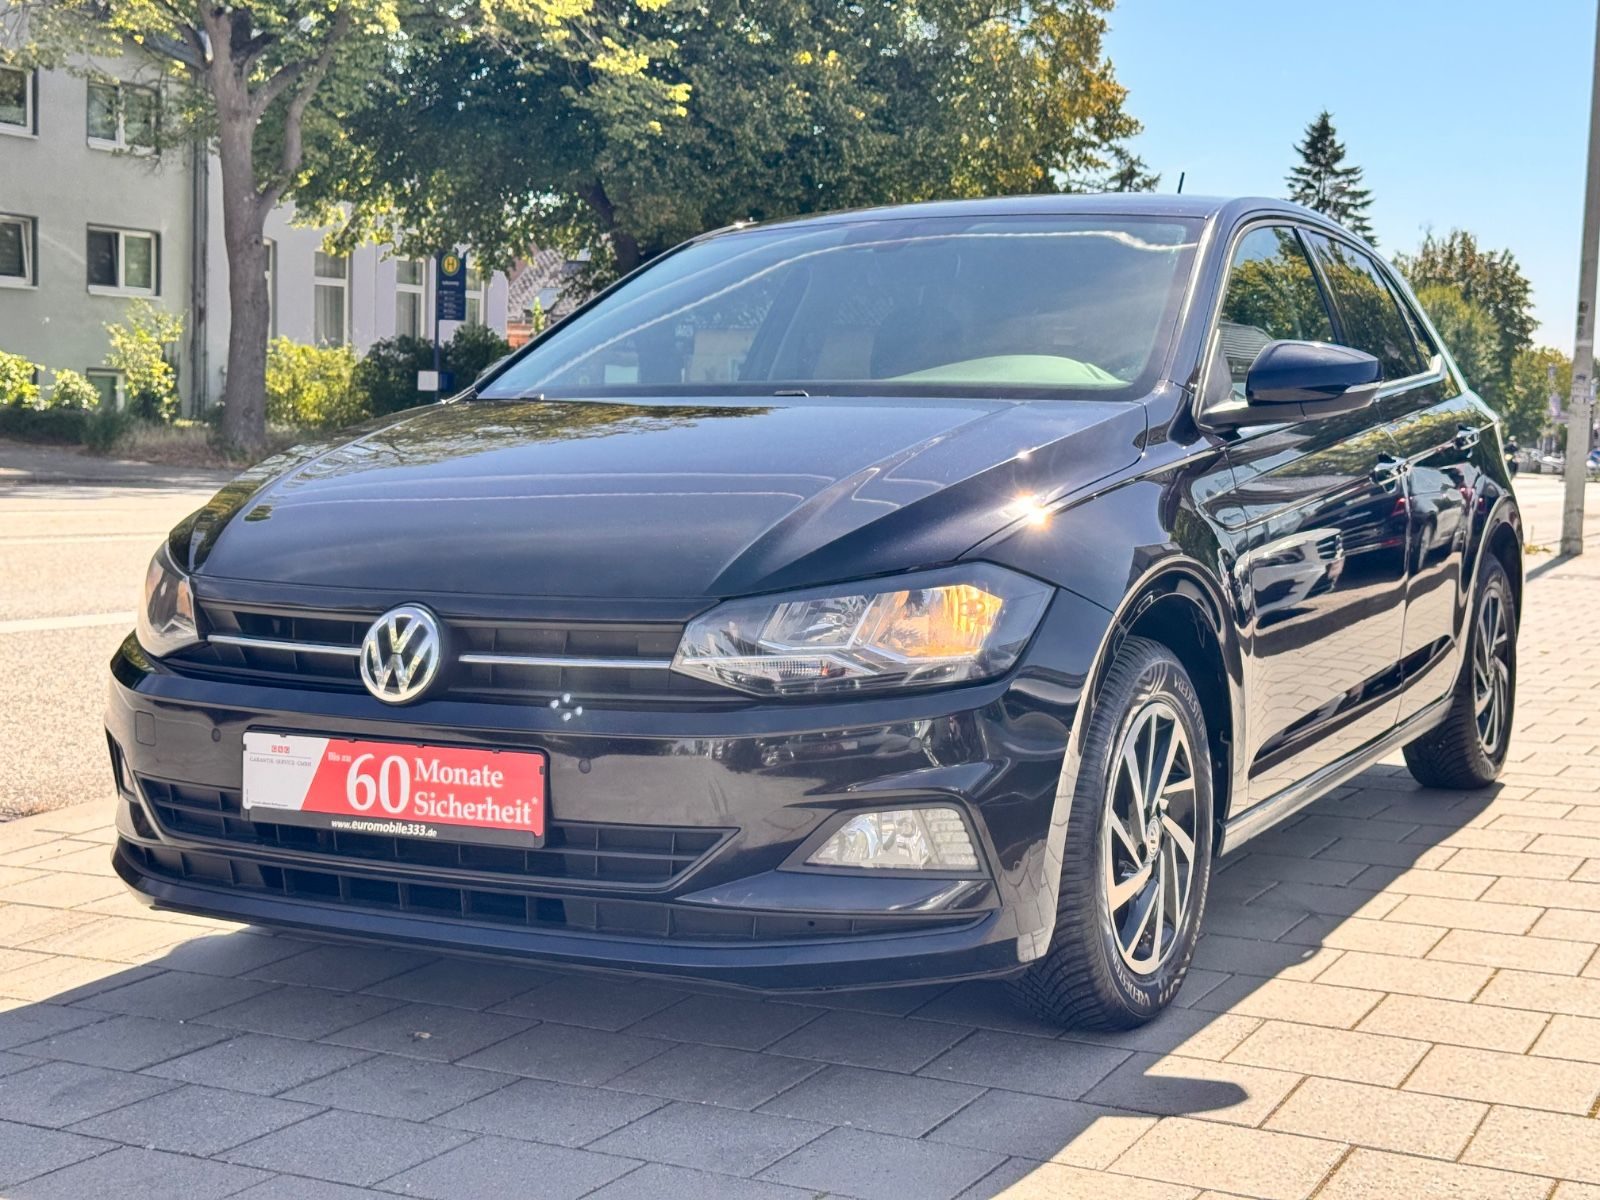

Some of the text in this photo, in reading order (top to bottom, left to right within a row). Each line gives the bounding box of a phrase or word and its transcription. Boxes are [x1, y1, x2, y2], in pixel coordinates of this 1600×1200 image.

[360, 605, 441, 703] VW
[346, 753, 411, 814] 60
[414, 757, 504, 788] Monate
[331, 820, 438, 838] www.euromobile333.de
